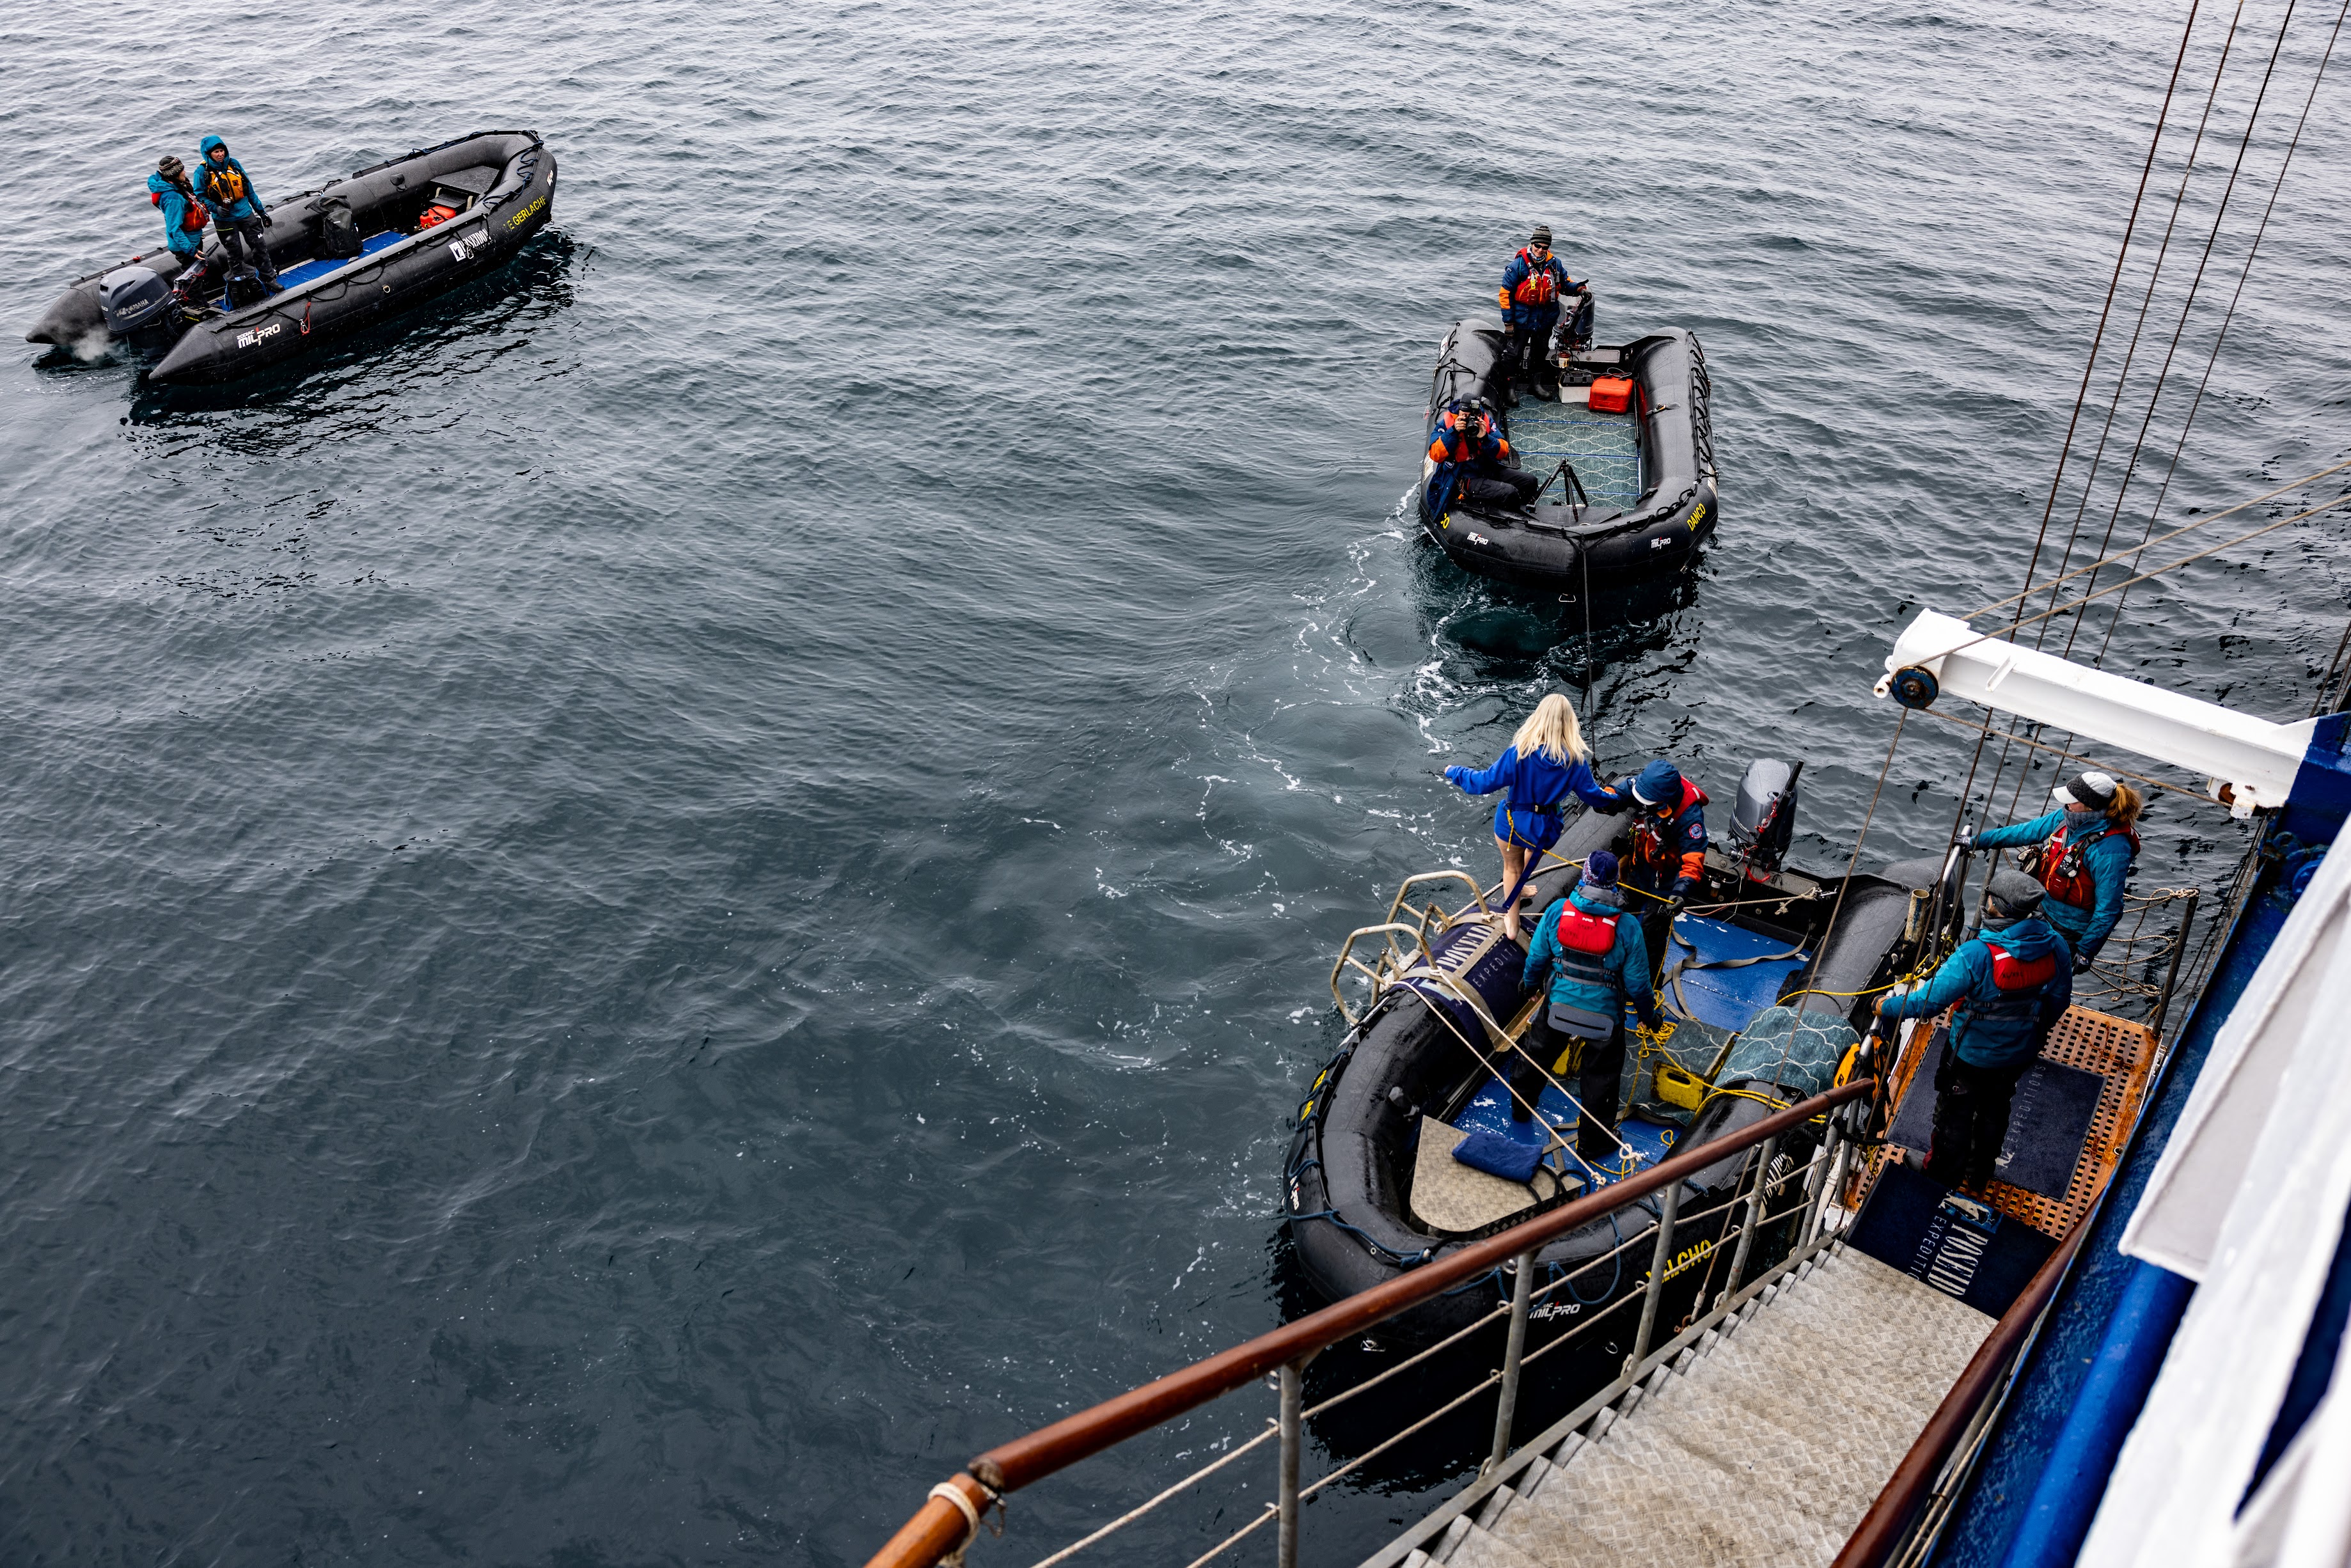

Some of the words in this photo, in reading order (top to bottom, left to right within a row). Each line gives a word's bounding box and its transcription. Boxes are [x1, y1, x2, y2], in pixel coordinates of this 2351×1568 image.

[237, 329, 255, 340] ZODIAC
[238, 323, 281, 349] MILPRO
[1687, 503, 1706, 531] DANCO
[1467, 534, 1489, 545] MILPRO
[1651, 537, 1671, 549] MILPRO
[2007, 1065, 2046, 1143] EXPEDITIONS
[1927, 1223, 1989, 1296] POSEID
